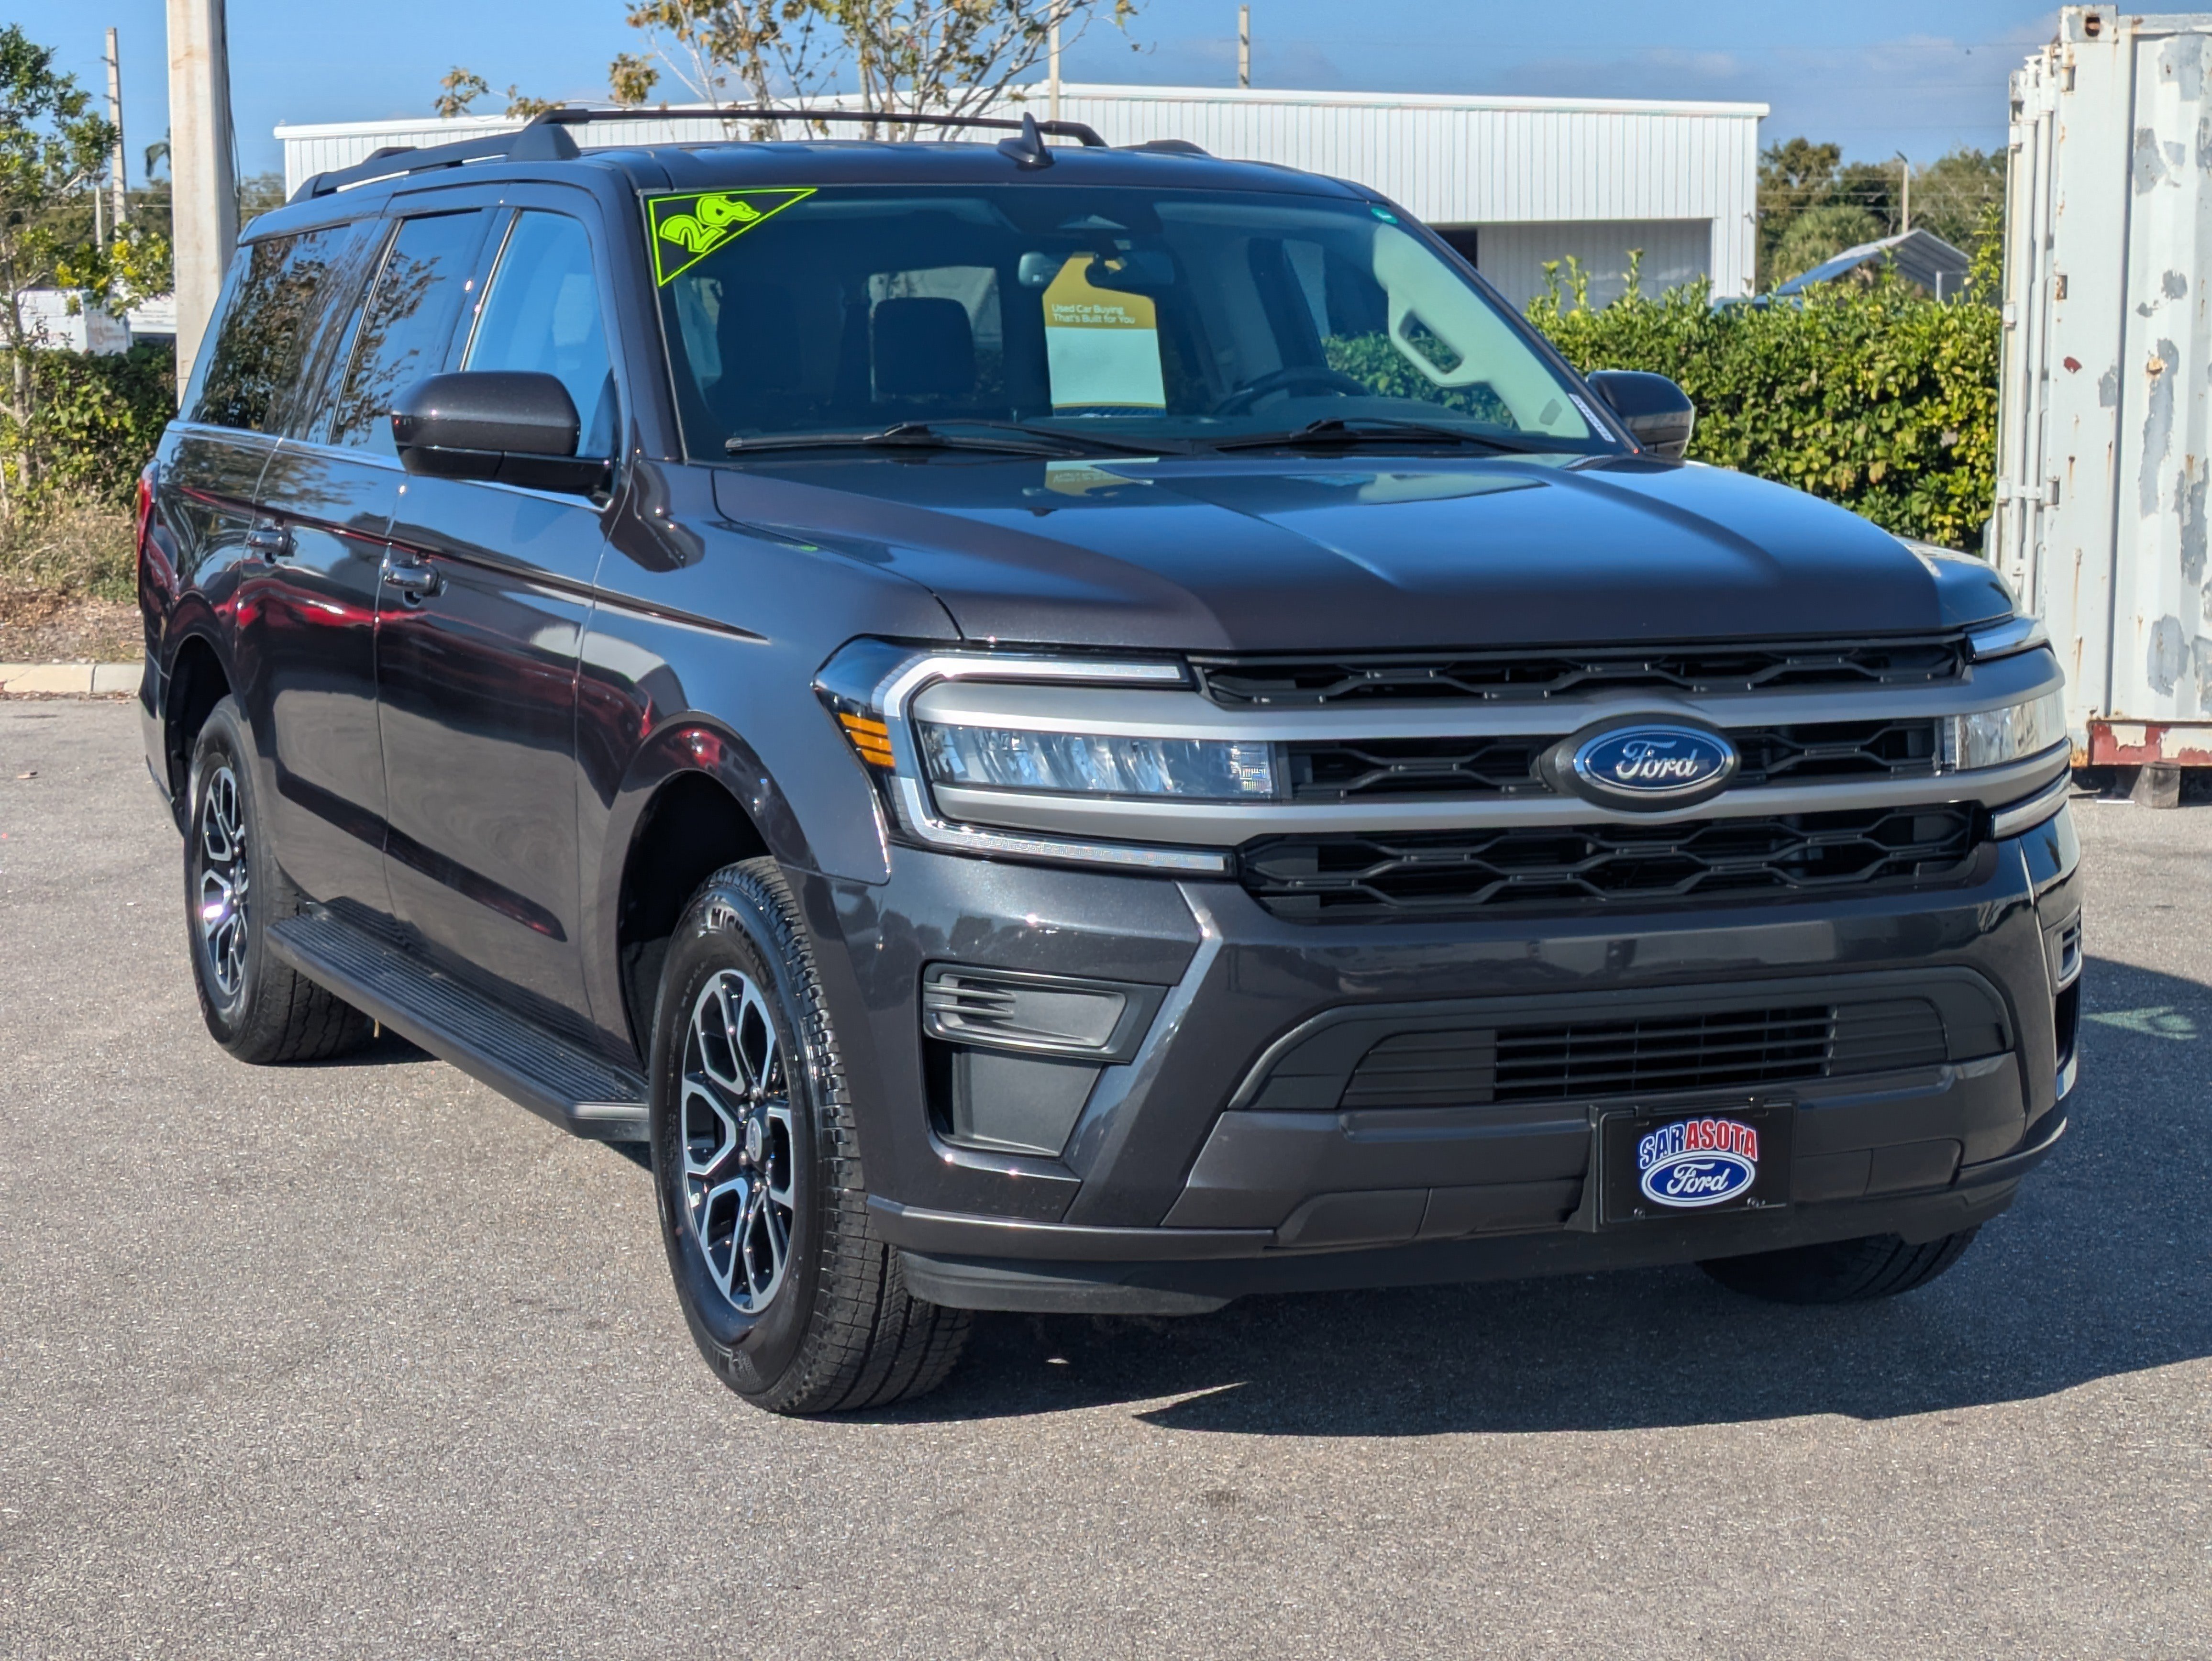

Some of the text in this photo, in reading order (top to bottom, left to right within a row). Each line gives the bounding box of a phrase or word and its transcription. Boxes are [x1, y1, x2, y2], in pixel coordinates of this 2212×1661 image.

[659, 195, 761, 253] 24
[1051, 303, 1124, 315] Used Car Buying
[1054, 313, 1136, 324] That's Built for You
[1616, 740, 1698, 779] Ford
[1639, 1118, 1759, 1170] SARASOTA
[1666, 1162, 1731, 1195] Ford
